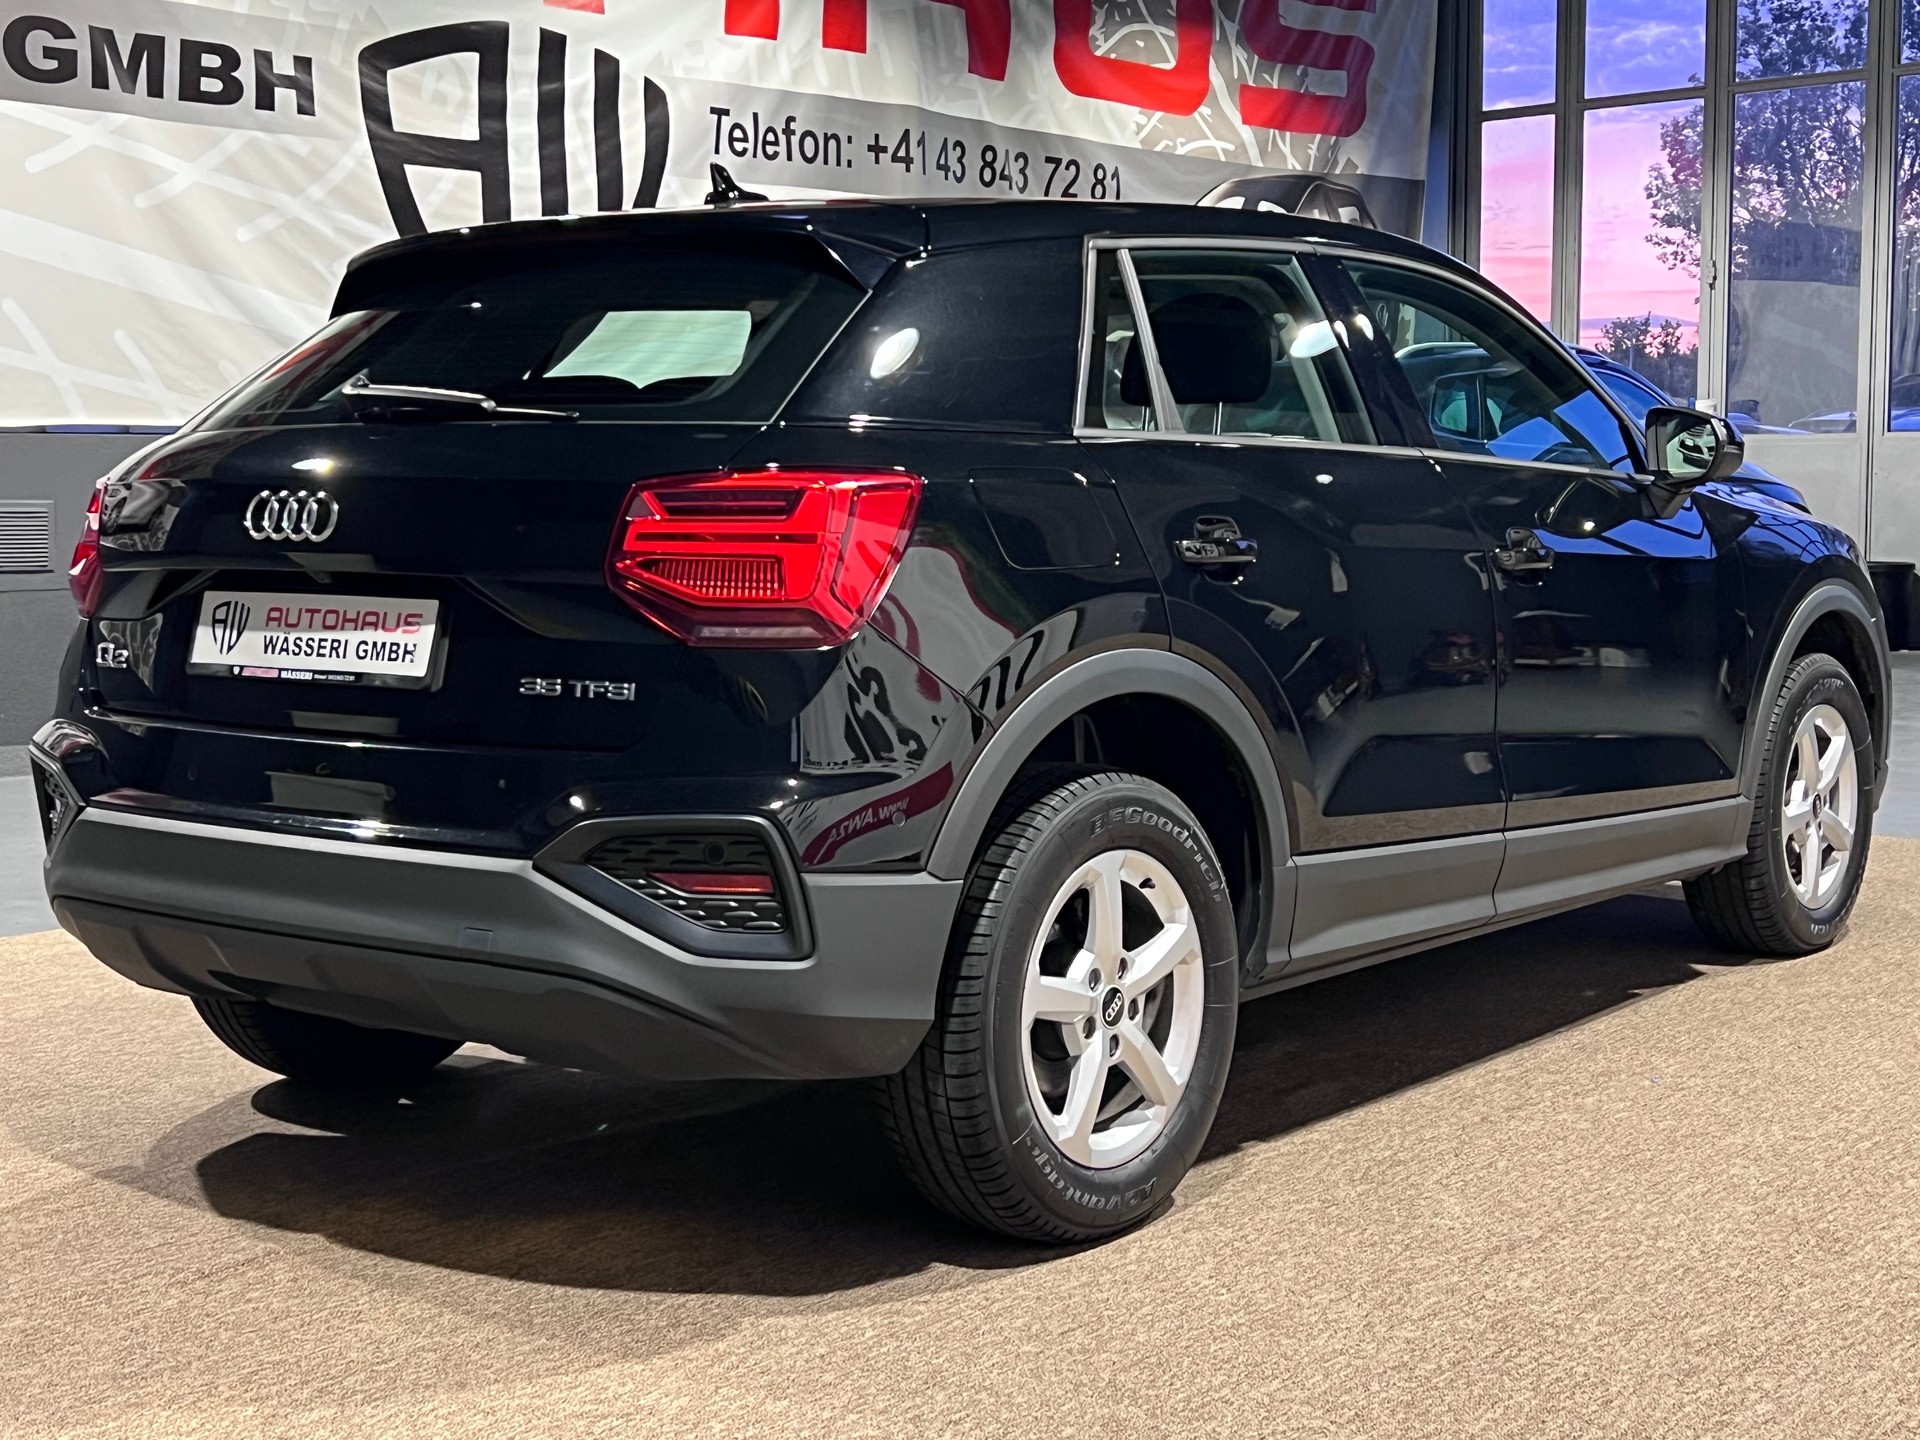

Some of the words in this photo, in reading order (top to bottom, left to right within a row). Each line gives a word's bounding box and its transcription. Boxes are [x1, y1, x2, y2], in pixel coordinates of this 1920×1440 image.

[2, 15, 316, 117] GMBH
[709, 106, 852, 168] Telefon:
[979, 144, 1029, 194] 843
[1044, 156, 1080, 198] 72
[1091, 162, 1120, 200] 81
[265, 606, 423, 634] AUTOHAUS
[96, 641, 129, 668] Q2
[263, 631, 348, 659] WÄSSERI
[355, 640, 417, 664] GMBH
[519, 678, 562, 697] 35
[568, 680, 636, 701] TFSI
[1089, 806, 1224, 904] BFGoodrich
